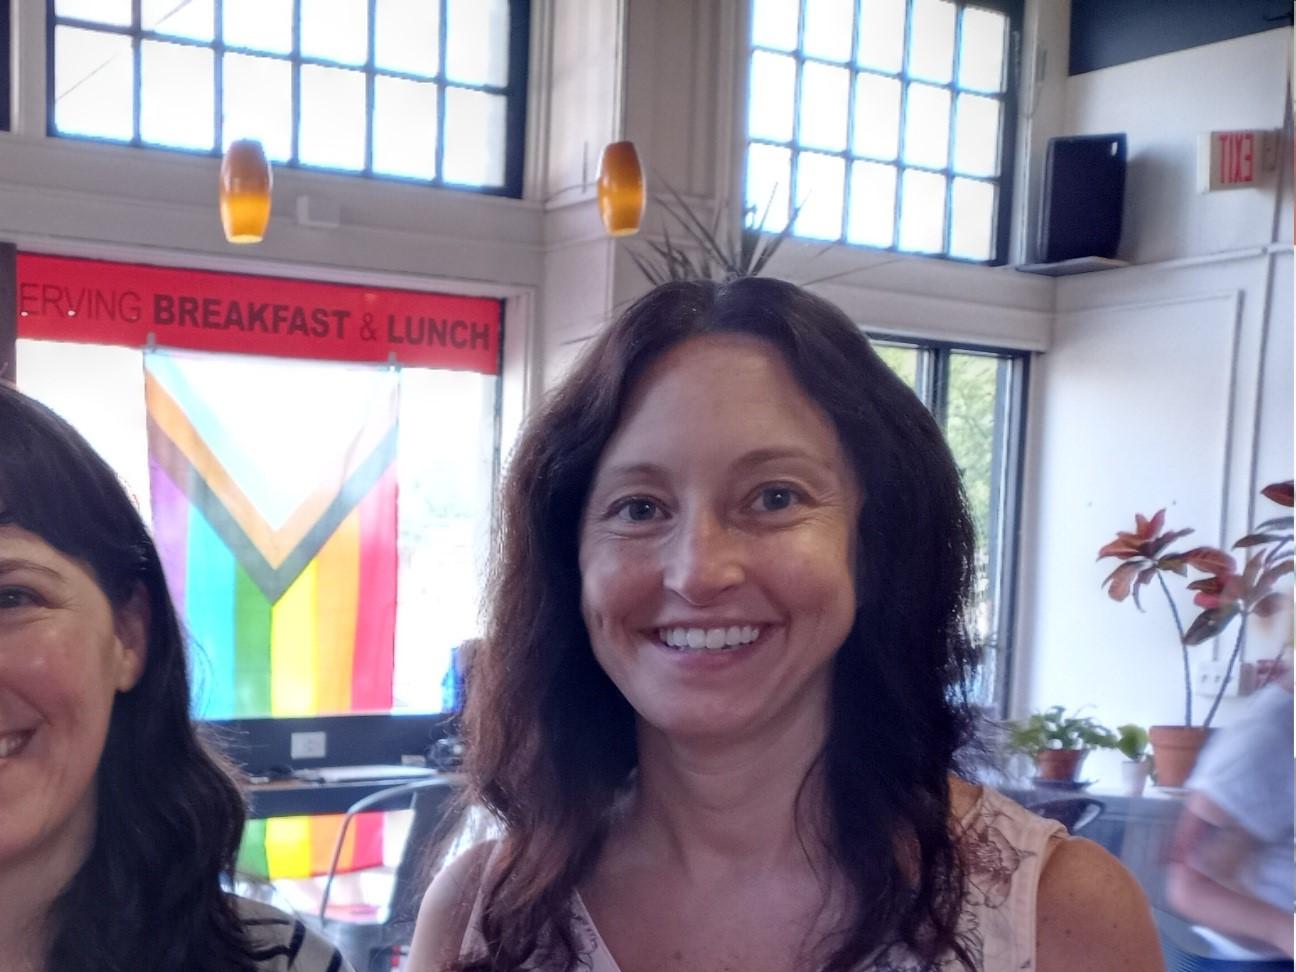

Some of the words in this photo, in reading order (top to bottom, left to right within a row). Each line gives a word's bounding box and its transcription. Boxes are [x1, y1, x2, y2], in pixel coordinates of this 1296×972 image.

[20, 282, 142, 322] ERVING
[153, 294, 351, 339] BREAKFAST
[360, 313, 378, 341] &
[387, 314, 490, 350] LUNCH
